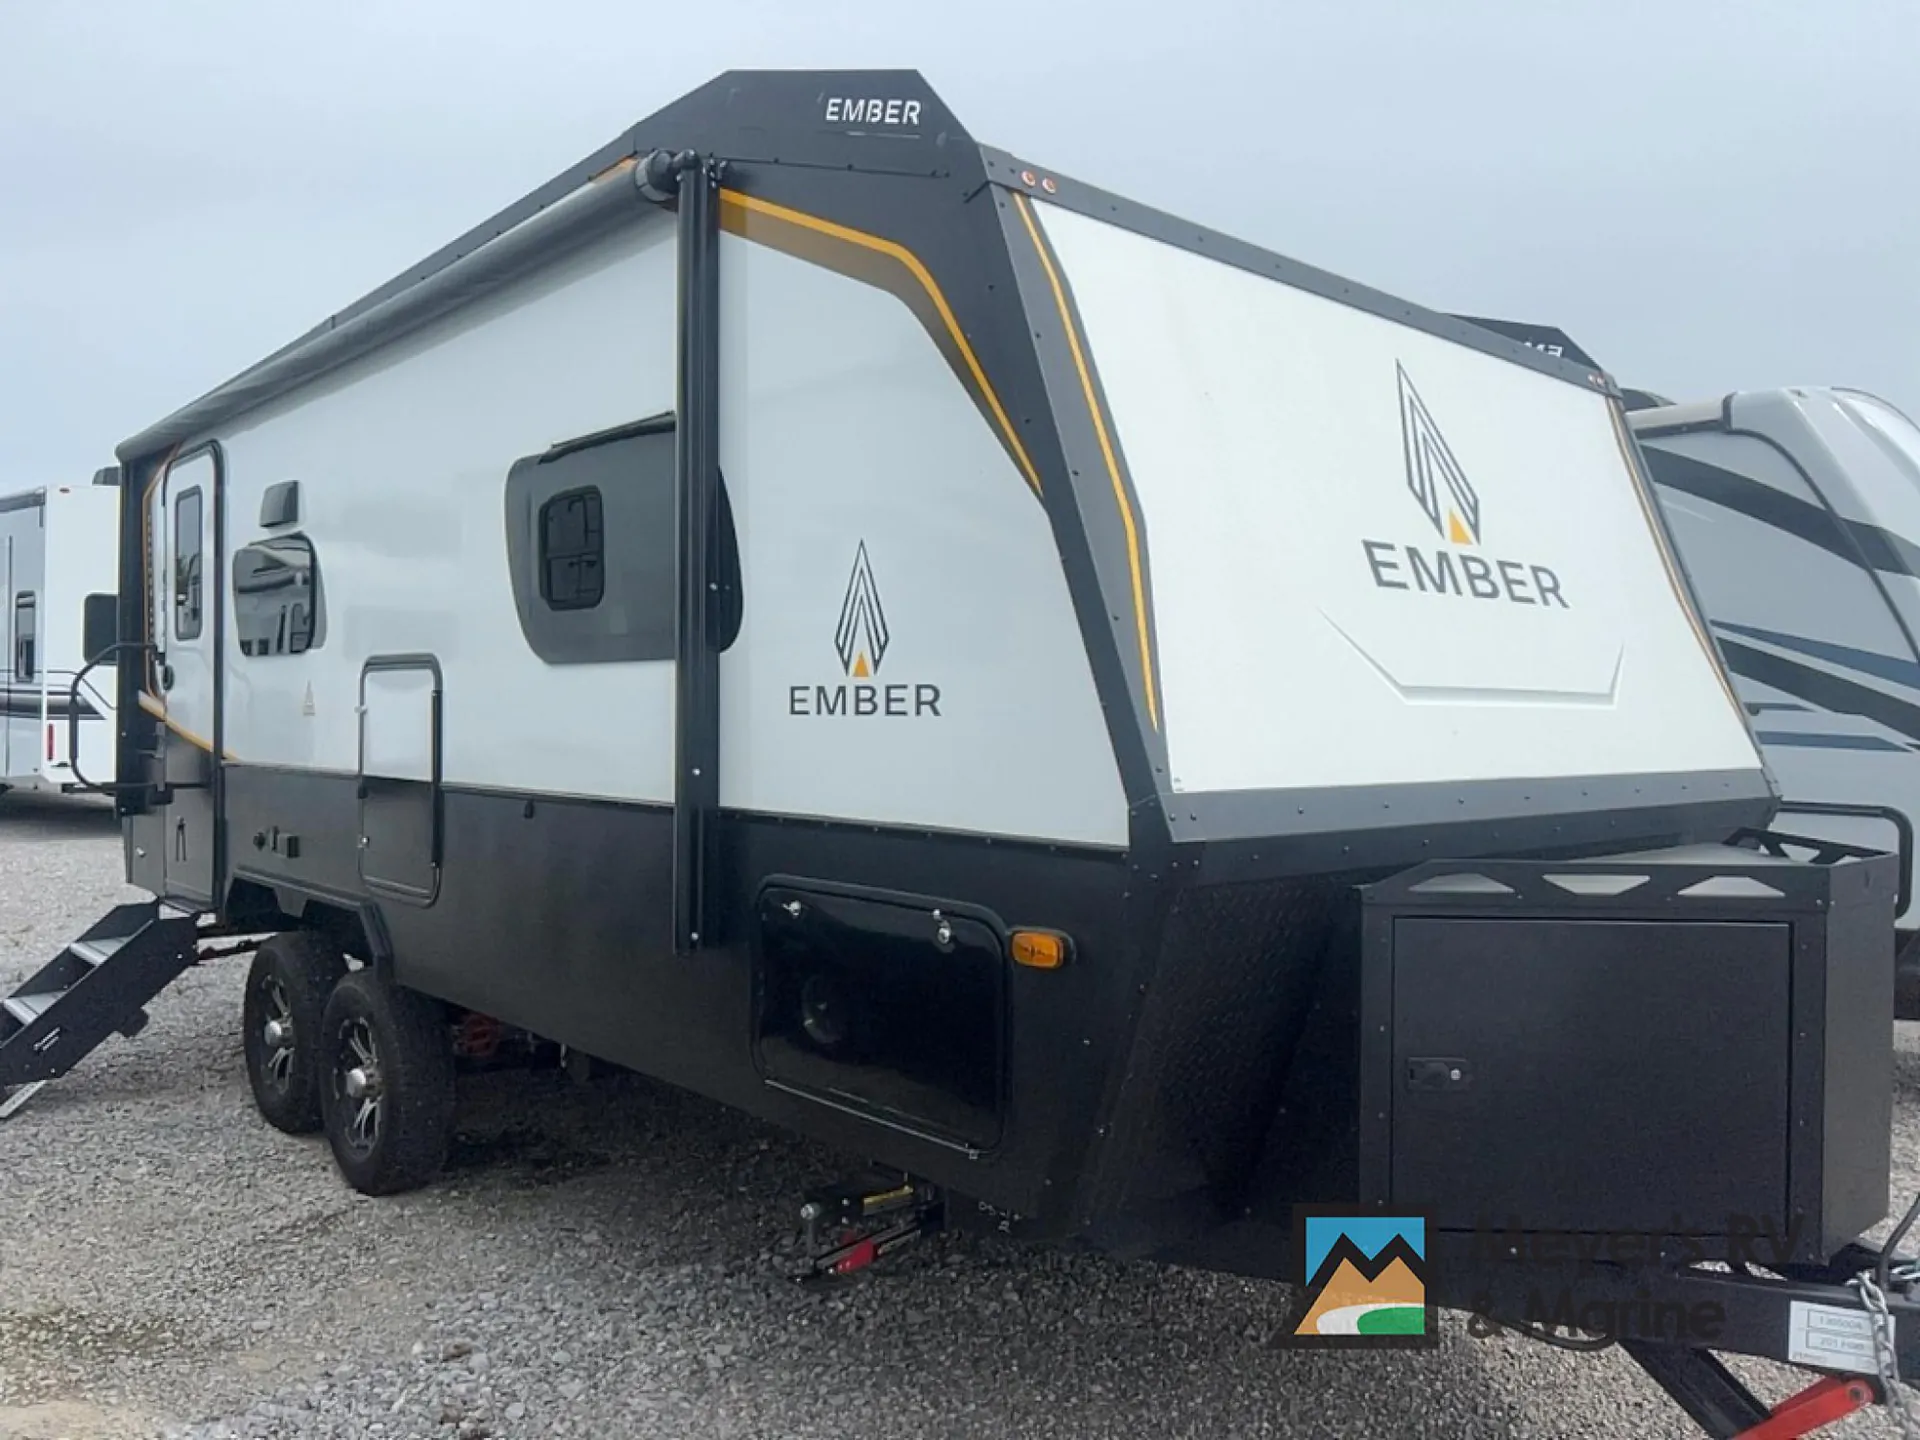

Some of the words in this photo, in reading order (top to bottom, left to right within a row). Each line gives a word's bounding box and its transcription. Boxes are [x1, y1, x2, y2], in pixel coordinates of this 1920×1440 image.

[826, 97, 921, 125] EMBER
[1361, 538, 1571, 609] EMBER
[789, 683, 942, 717] EMBER
